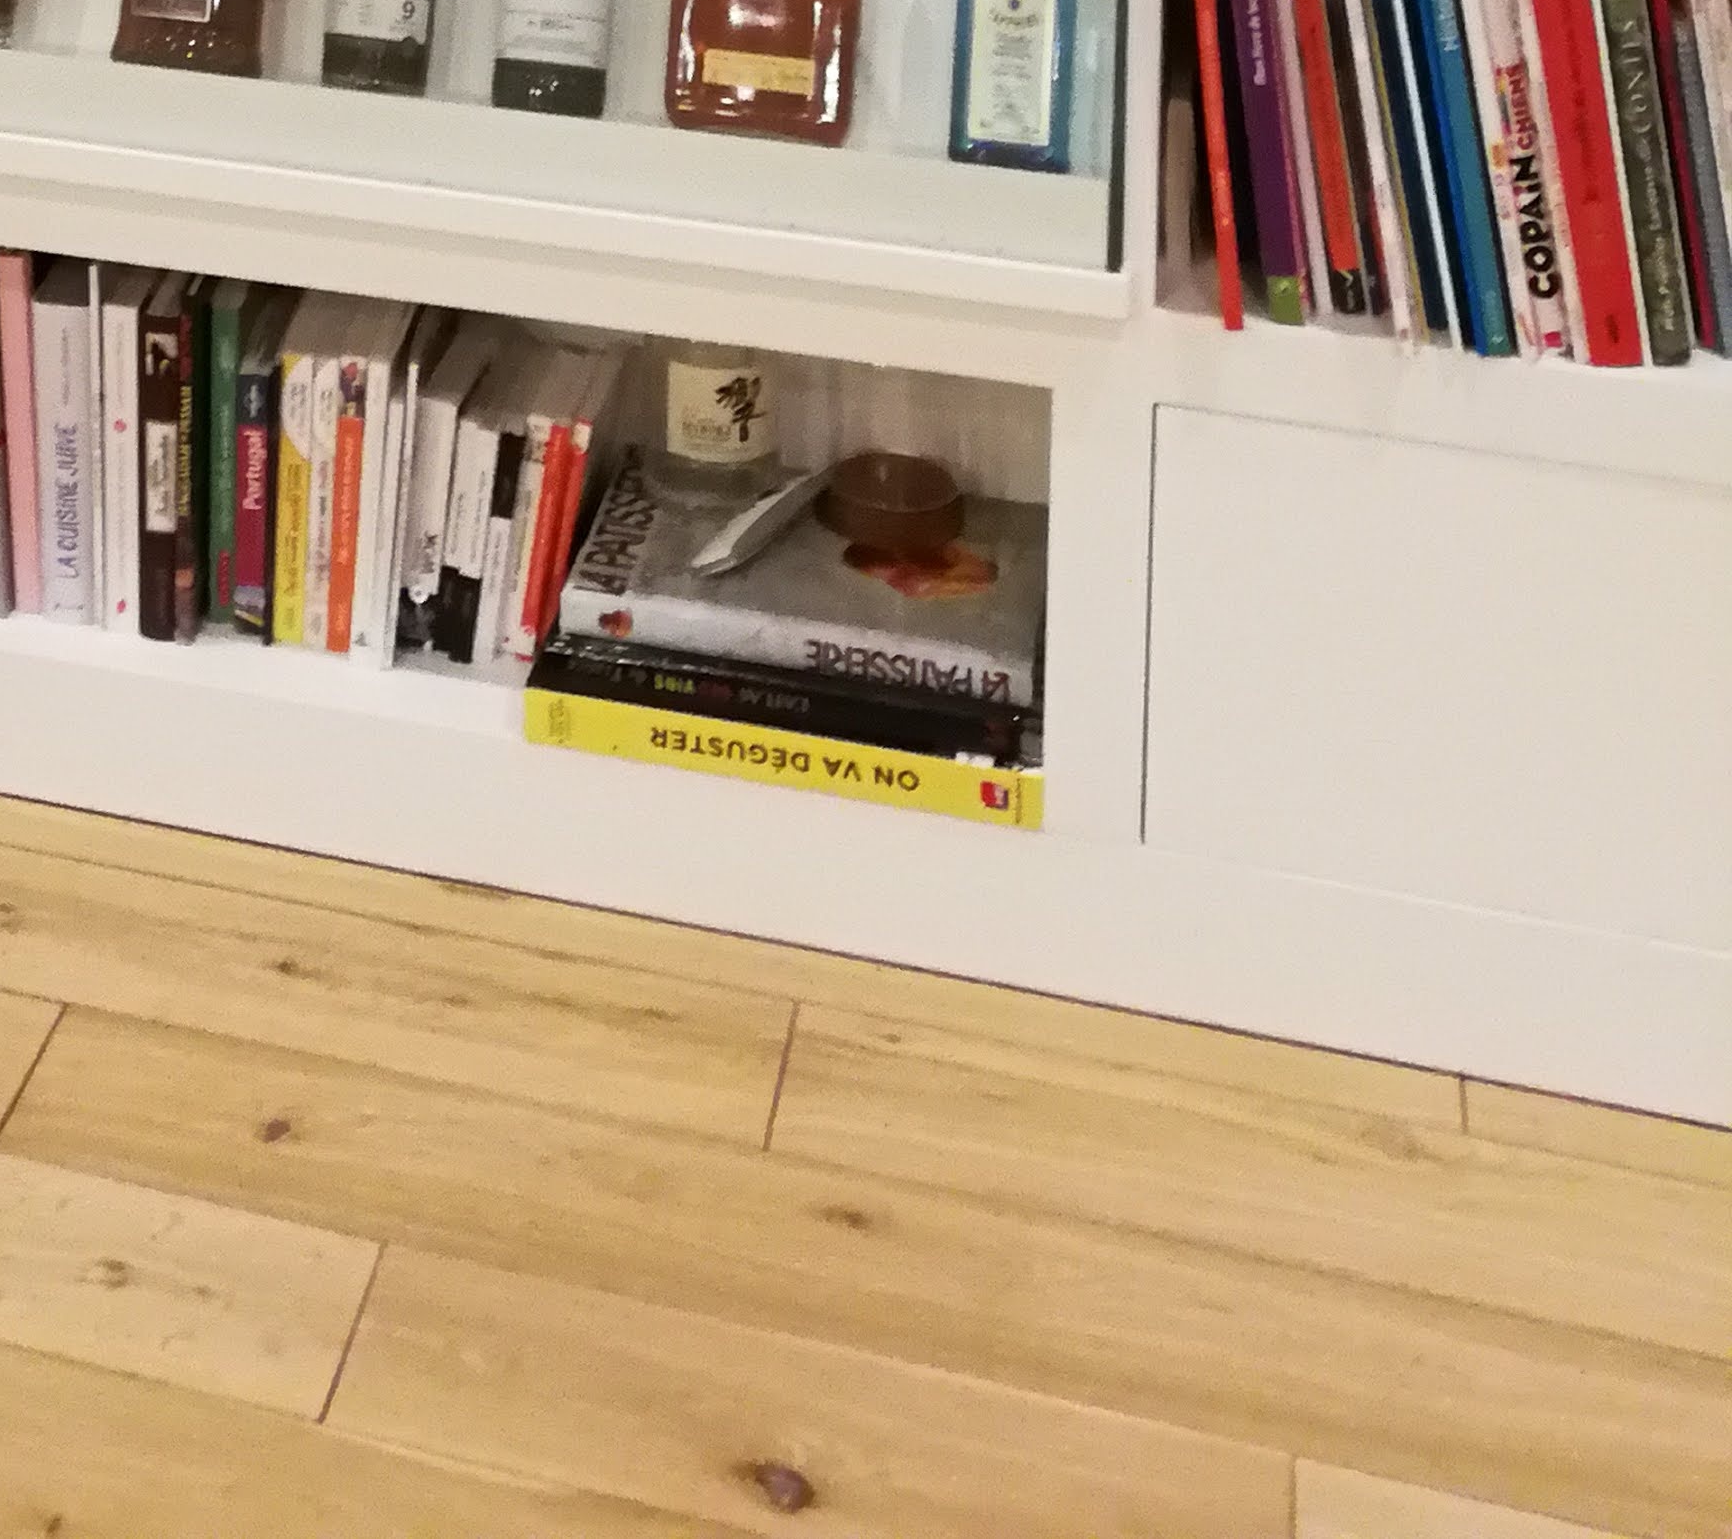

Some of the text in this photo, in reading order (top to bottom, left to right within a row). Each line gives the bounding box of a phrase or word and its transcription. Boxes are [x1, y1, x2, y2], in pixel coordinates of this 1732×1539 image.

[401, 0, 417, 20] 9
[1508, 155, 1562, 299] COPAIN
[241, 429, 268, 511] Portugal
[650, 726, 921, 792] ON VA DÉGUSTER
